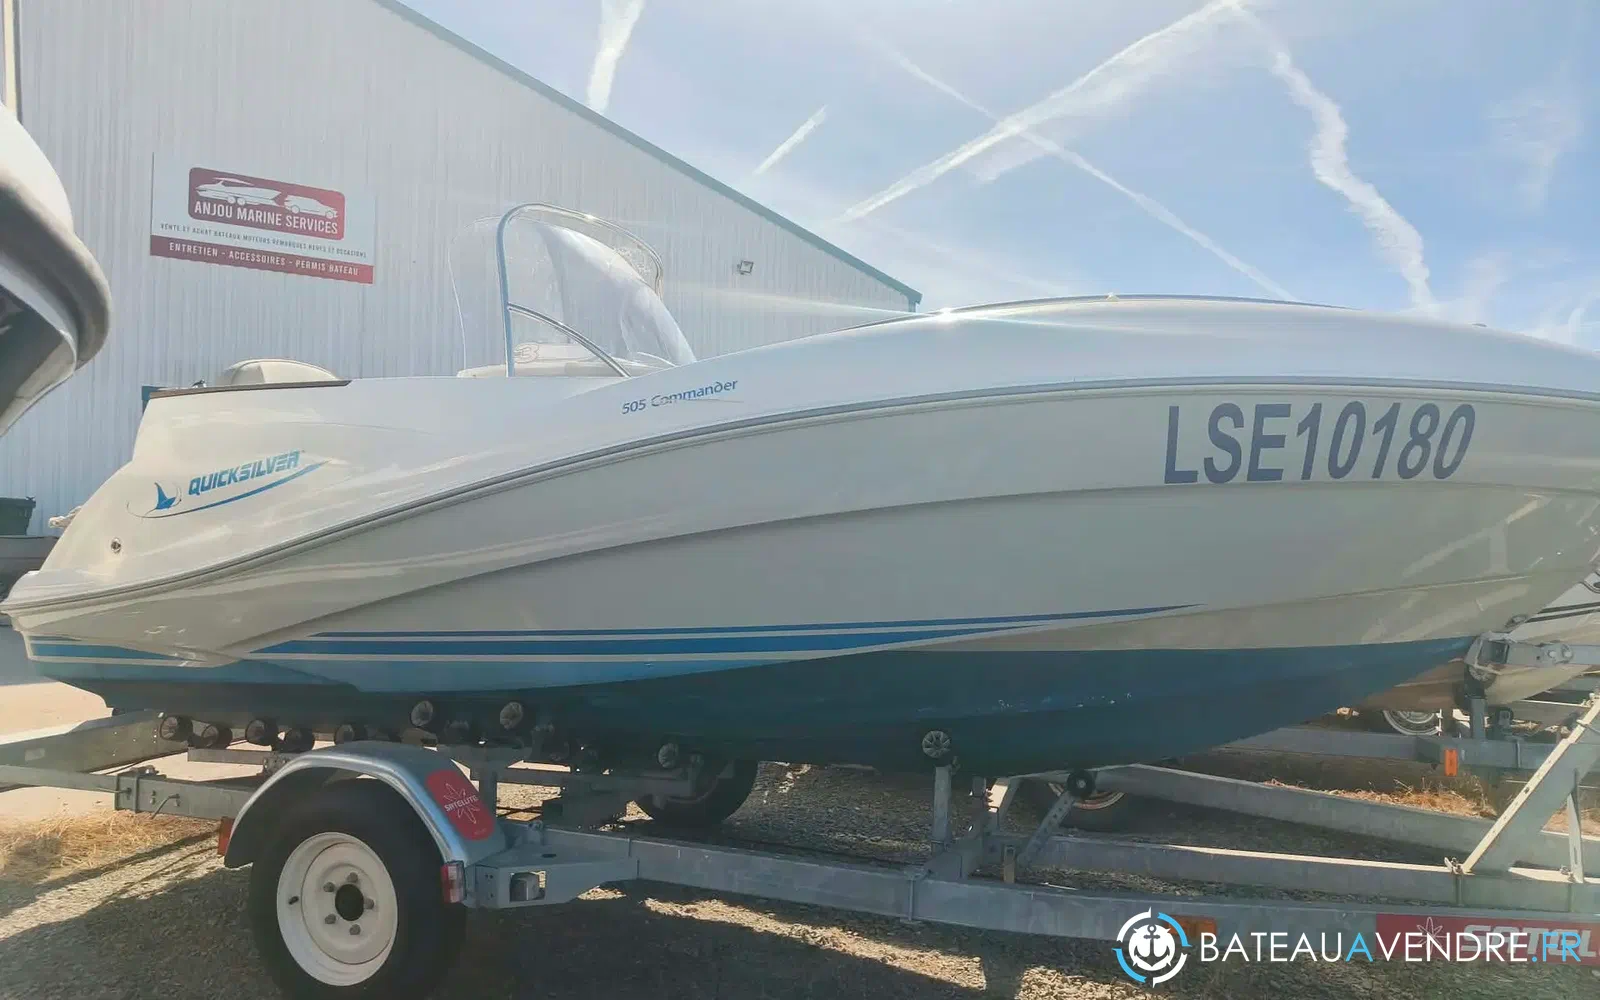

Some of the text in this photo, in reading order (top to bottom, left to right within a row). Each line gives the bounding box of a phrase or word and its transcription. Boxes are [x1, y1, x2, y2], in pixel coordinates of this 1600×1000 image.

[160, 223, 180, 232] VENTE
[192, 227, 212, 236] ACHAT
[214, 230, 241, 240] BATEAUX
[194, 200, 339, 235] ANJOU MARINE SERVICES
[169, 242, 218, 257] ENTRETIEN
[228, 250, 286, 266] ACCESSOIRES
[295, 259, 326, 272] PERMIS
[329, 264, 359, 276] BATEAU
[621, 379, 738, 415] 505 Commander
[1164, 400, 1476, 485] LSE10180
[188, 450, 300, 496] QUICKSILVER
[1460, 924, 1600, 958] SATEL
